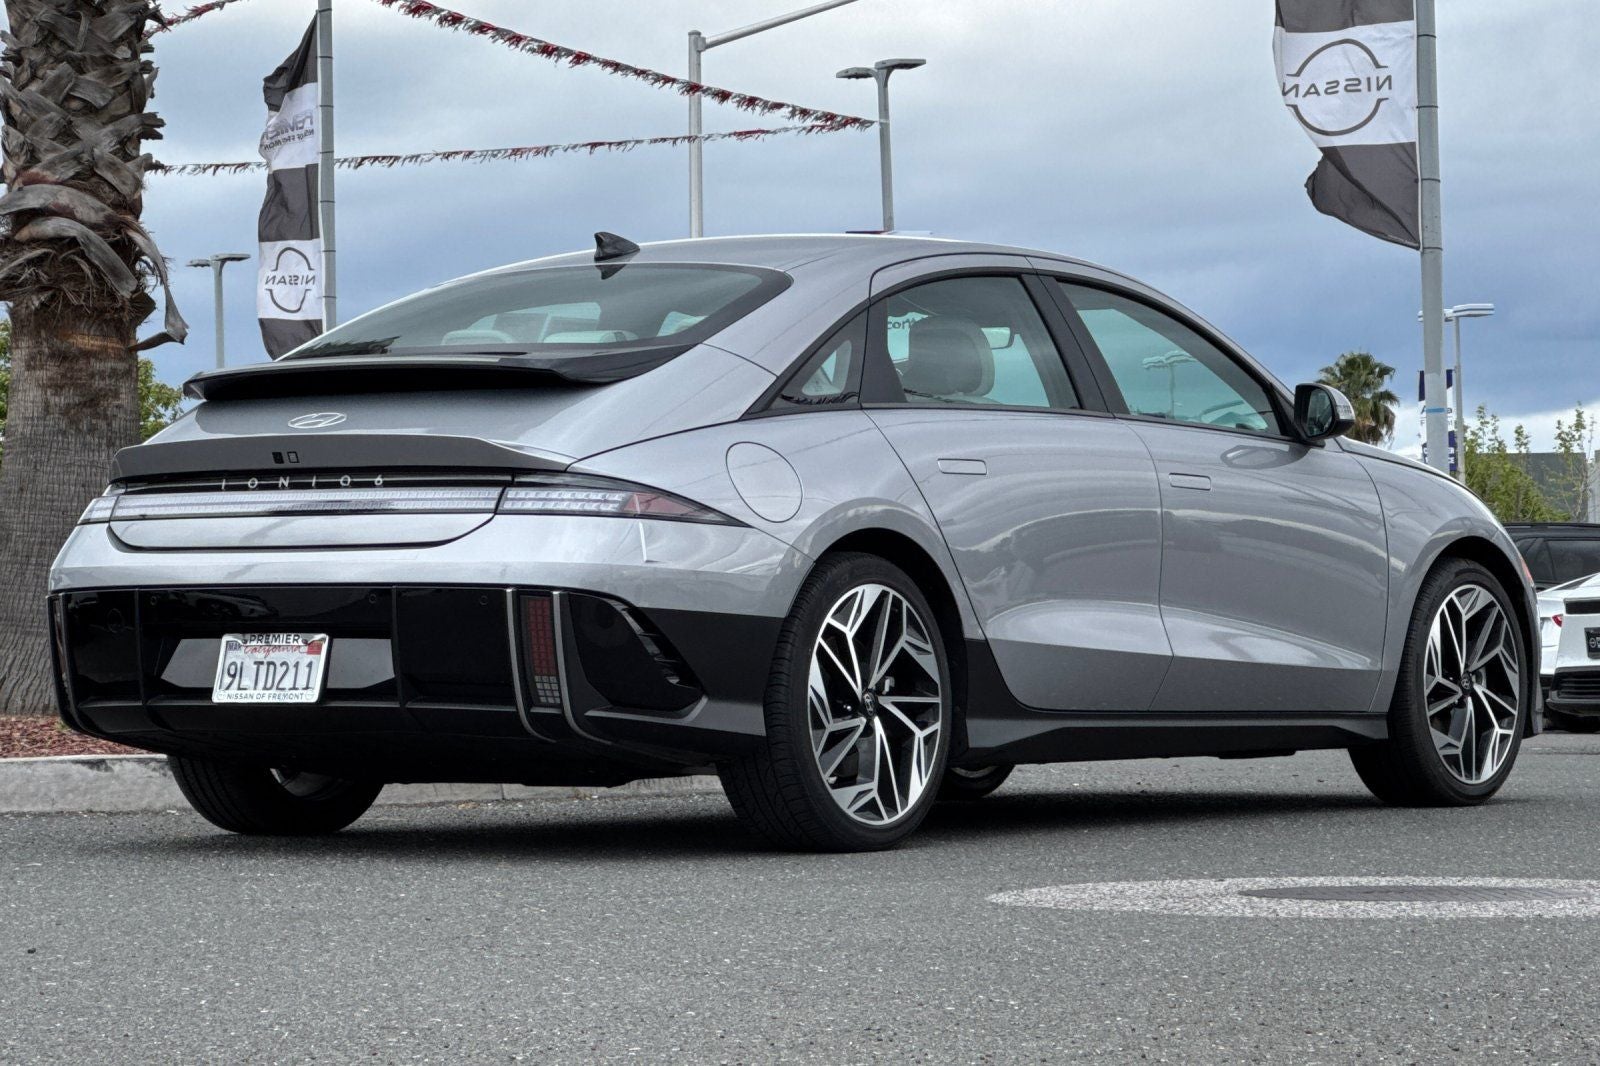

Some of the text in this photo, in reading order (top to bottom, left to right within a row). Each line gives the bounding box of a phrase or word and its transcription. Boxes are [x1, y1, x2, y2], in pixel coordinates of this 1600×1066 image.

[249, 634, 301, 645] PREMIER
[244, 645, 300, 658] California
[225, 660, 314, 691] 9LTD211
[226, 692, 304, 700] NISSAN OF FREMONT
